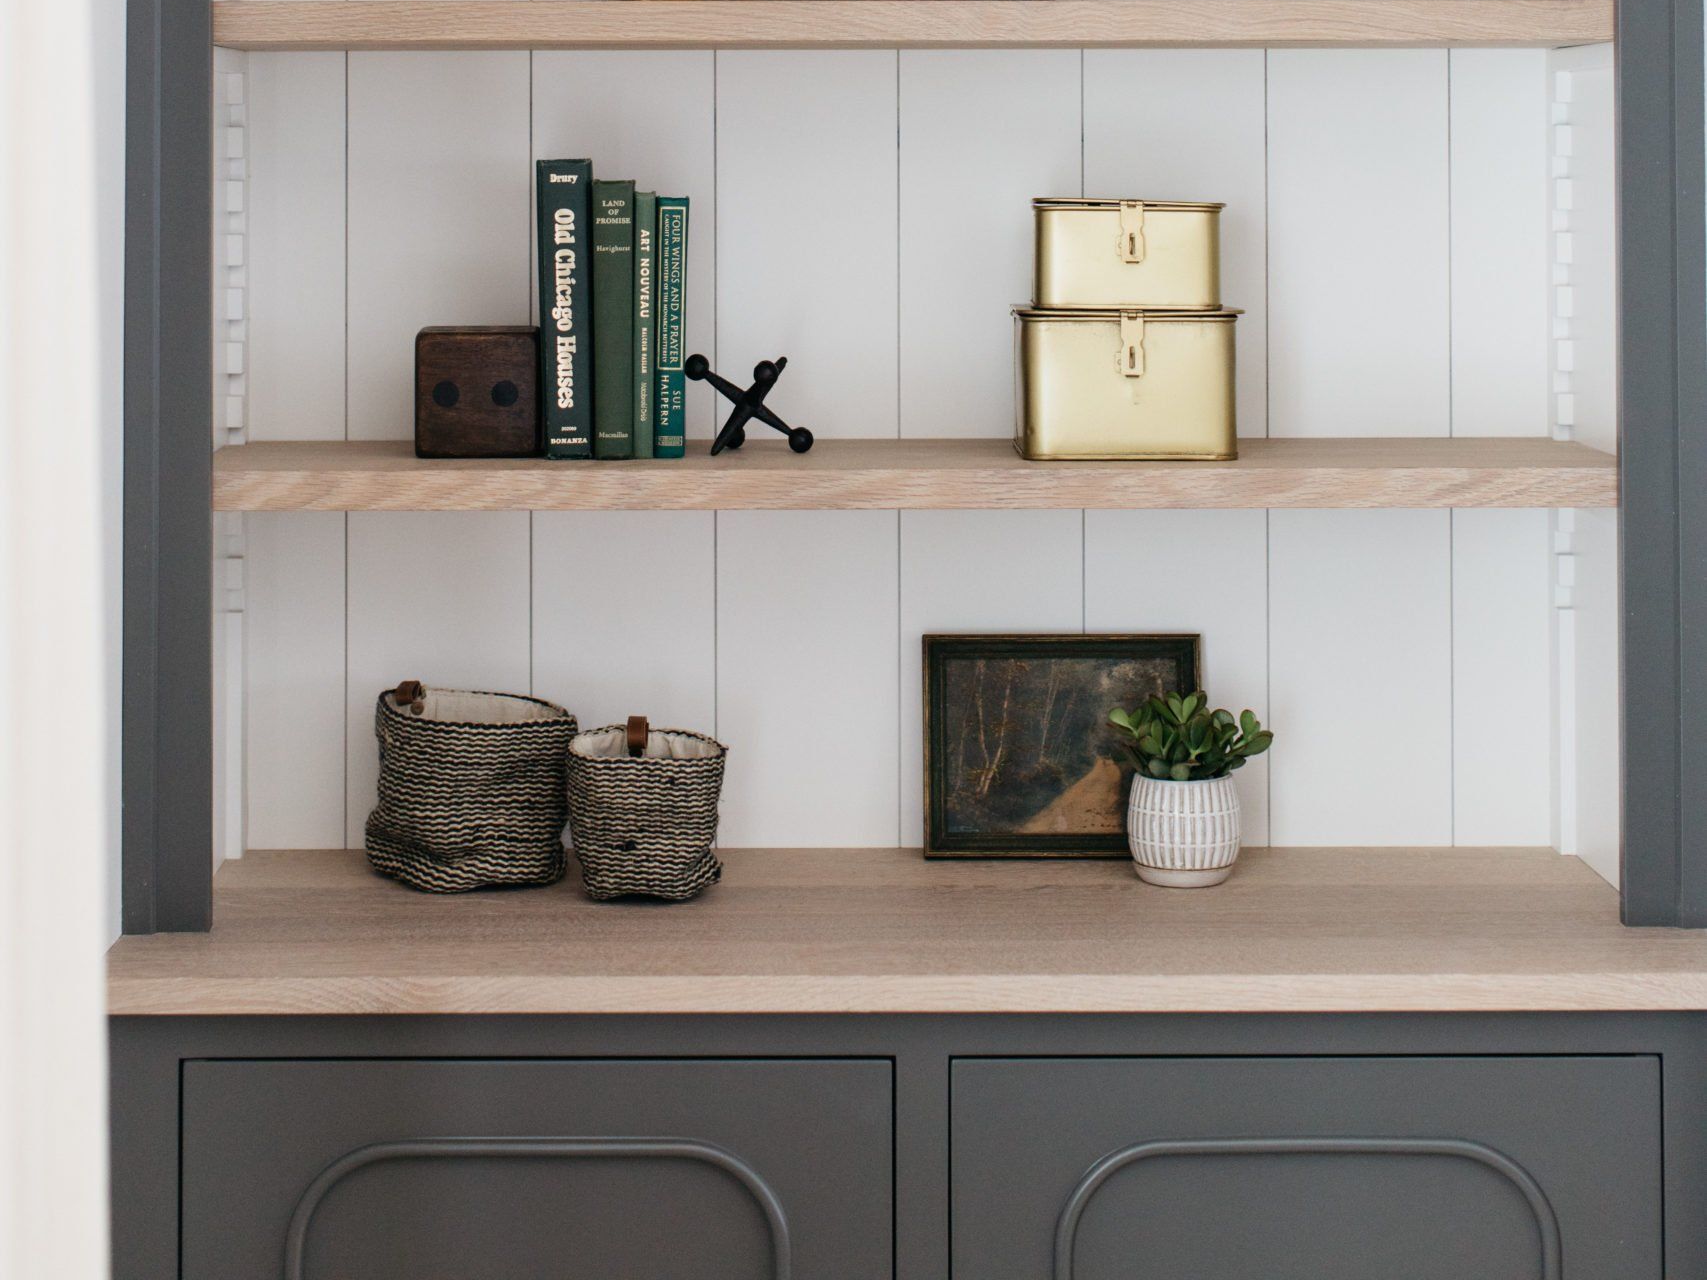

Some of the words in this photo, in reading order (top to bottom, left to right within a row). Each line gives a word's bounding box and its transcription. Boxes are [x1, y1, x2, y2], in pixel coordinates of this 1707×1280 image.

[550, 174, 578, 184] Drury
[554, 208, 575, 245] Old
[641, 229, 650, 252] ART
[671, 214, 680, 244] FOUR
[671, 247, 680, 283] WINGS
[552, 249, 576, 331] Chicago
[640, 258, 650, 318] NOUVEAU
[671, 287, 679, 311] AND
[670, 325, 678, 363] PRAYER
[556, 335, 576, 409] Houses
[660, 375, 669, 426] HALPERN
[672, 390, 681, 410] SUE
